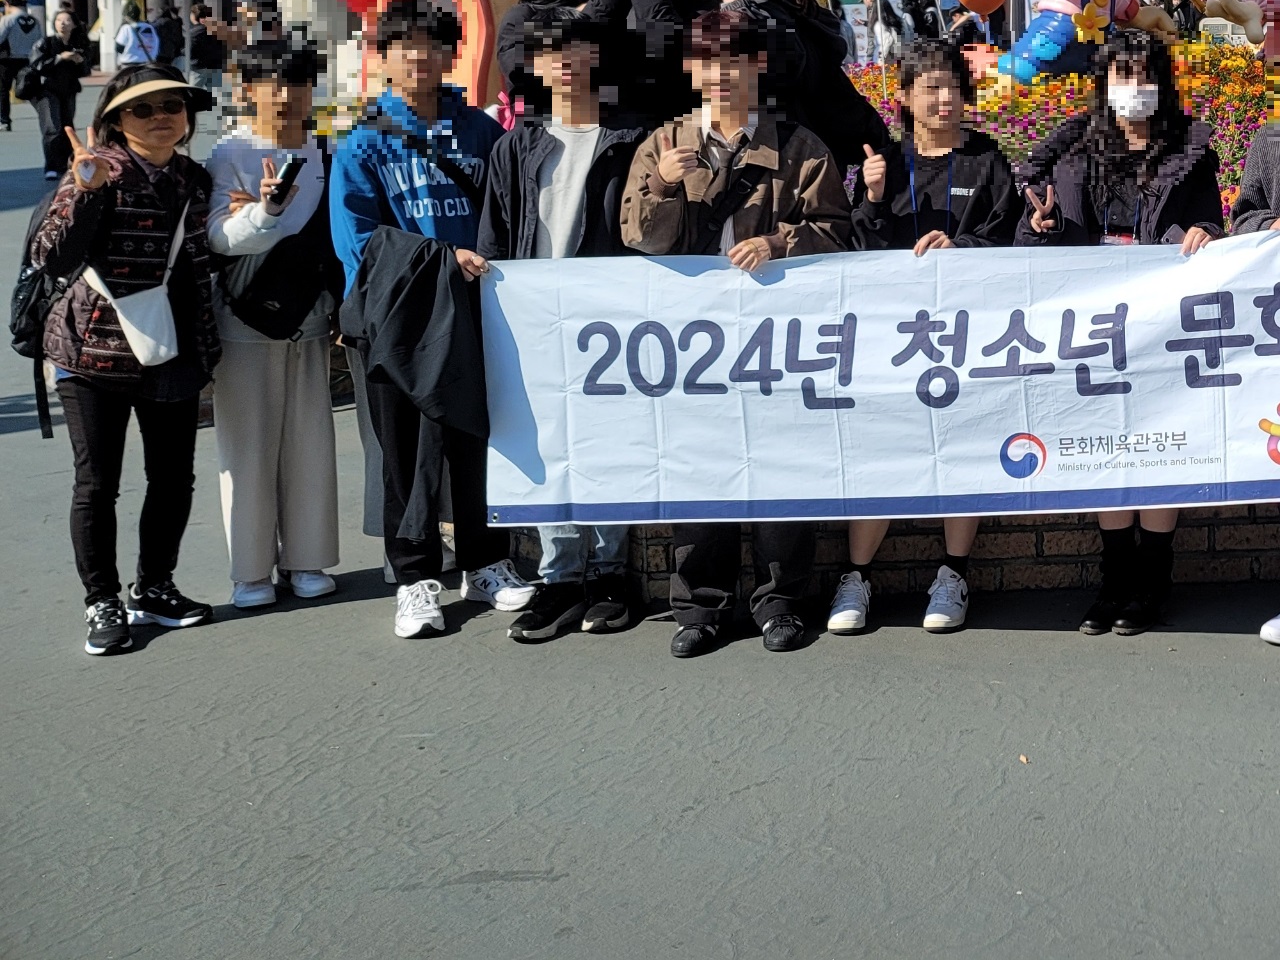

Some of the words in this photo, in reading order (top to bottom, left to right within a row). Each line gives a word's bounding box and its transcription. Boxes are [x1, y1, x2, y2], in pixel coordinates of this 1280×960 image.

[577, 312, 858, 410] 2024년
[891, 302, 1132, 409] 청소년
[1058, 430, 1188, 457] 문화체육관광부
[1057, 462, 1092, 472] Ministry
[1093, 461, 1103, 470] of
[1104, 460, 1138, 470] Culture,
[1139, 458, 1168, 468] Sports
[1170, 457, 1187, 466] and
[1188, 456, 1222, 465] Tourism
